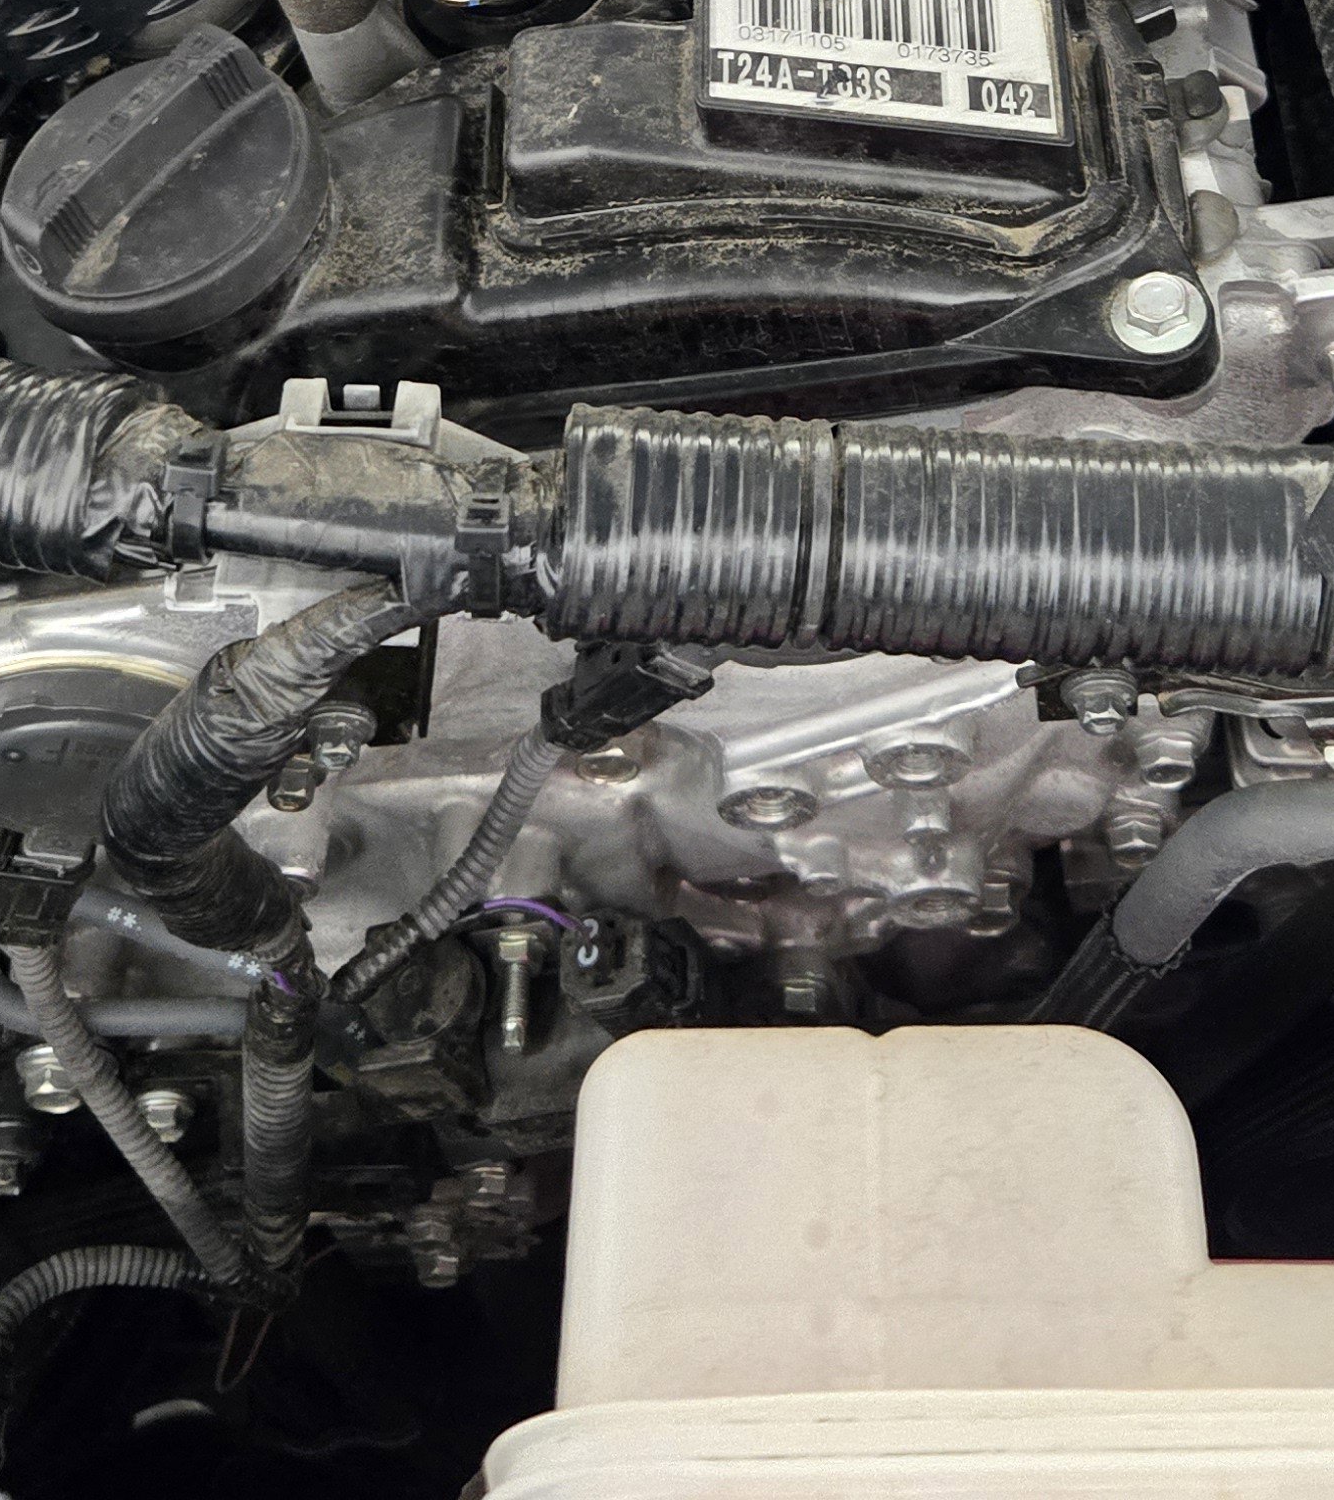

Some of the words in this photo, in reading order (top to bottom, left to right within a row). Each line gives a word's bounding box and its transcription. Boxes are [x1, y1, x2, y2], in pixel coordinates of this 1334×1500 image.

[738, 25, 847, 52] 03171105
[898, 43, 992, 67] 0173735
[980, 80, 1036, 118] 042
